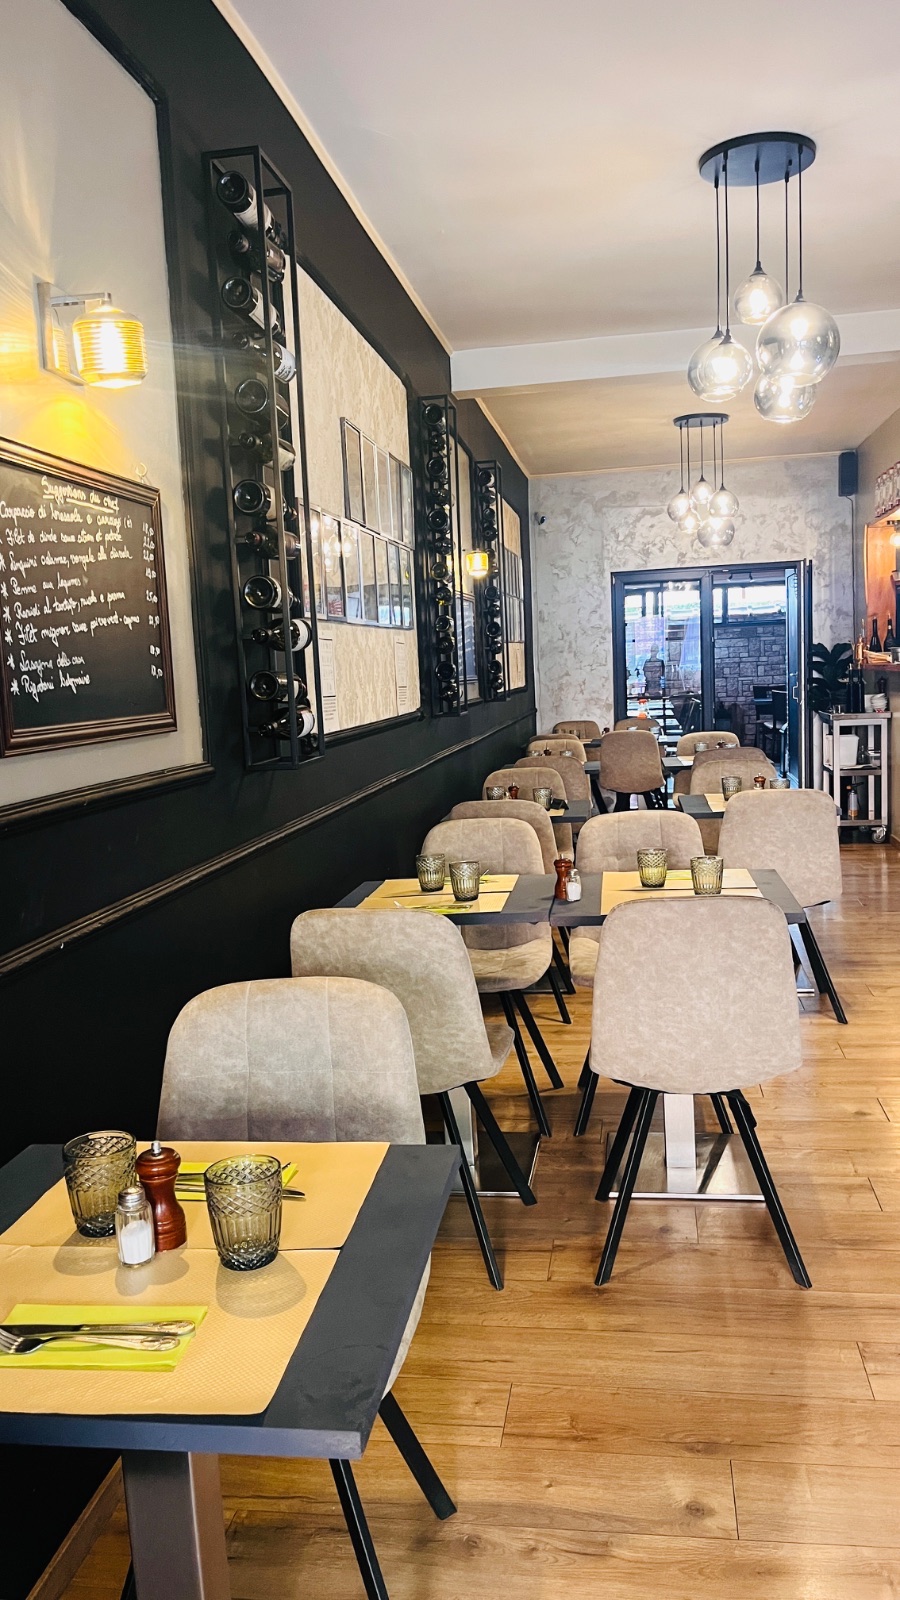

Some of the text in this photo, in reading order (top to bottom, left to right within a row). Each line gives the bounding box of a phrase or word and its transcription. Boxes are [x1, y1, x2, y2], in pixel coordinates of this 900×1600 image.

[38, 503, 47, 519] di
[5, 527, 25, 547] Filet
[10, 576, 37, 596] Penne
[15, 621, 38, 646] Filet
